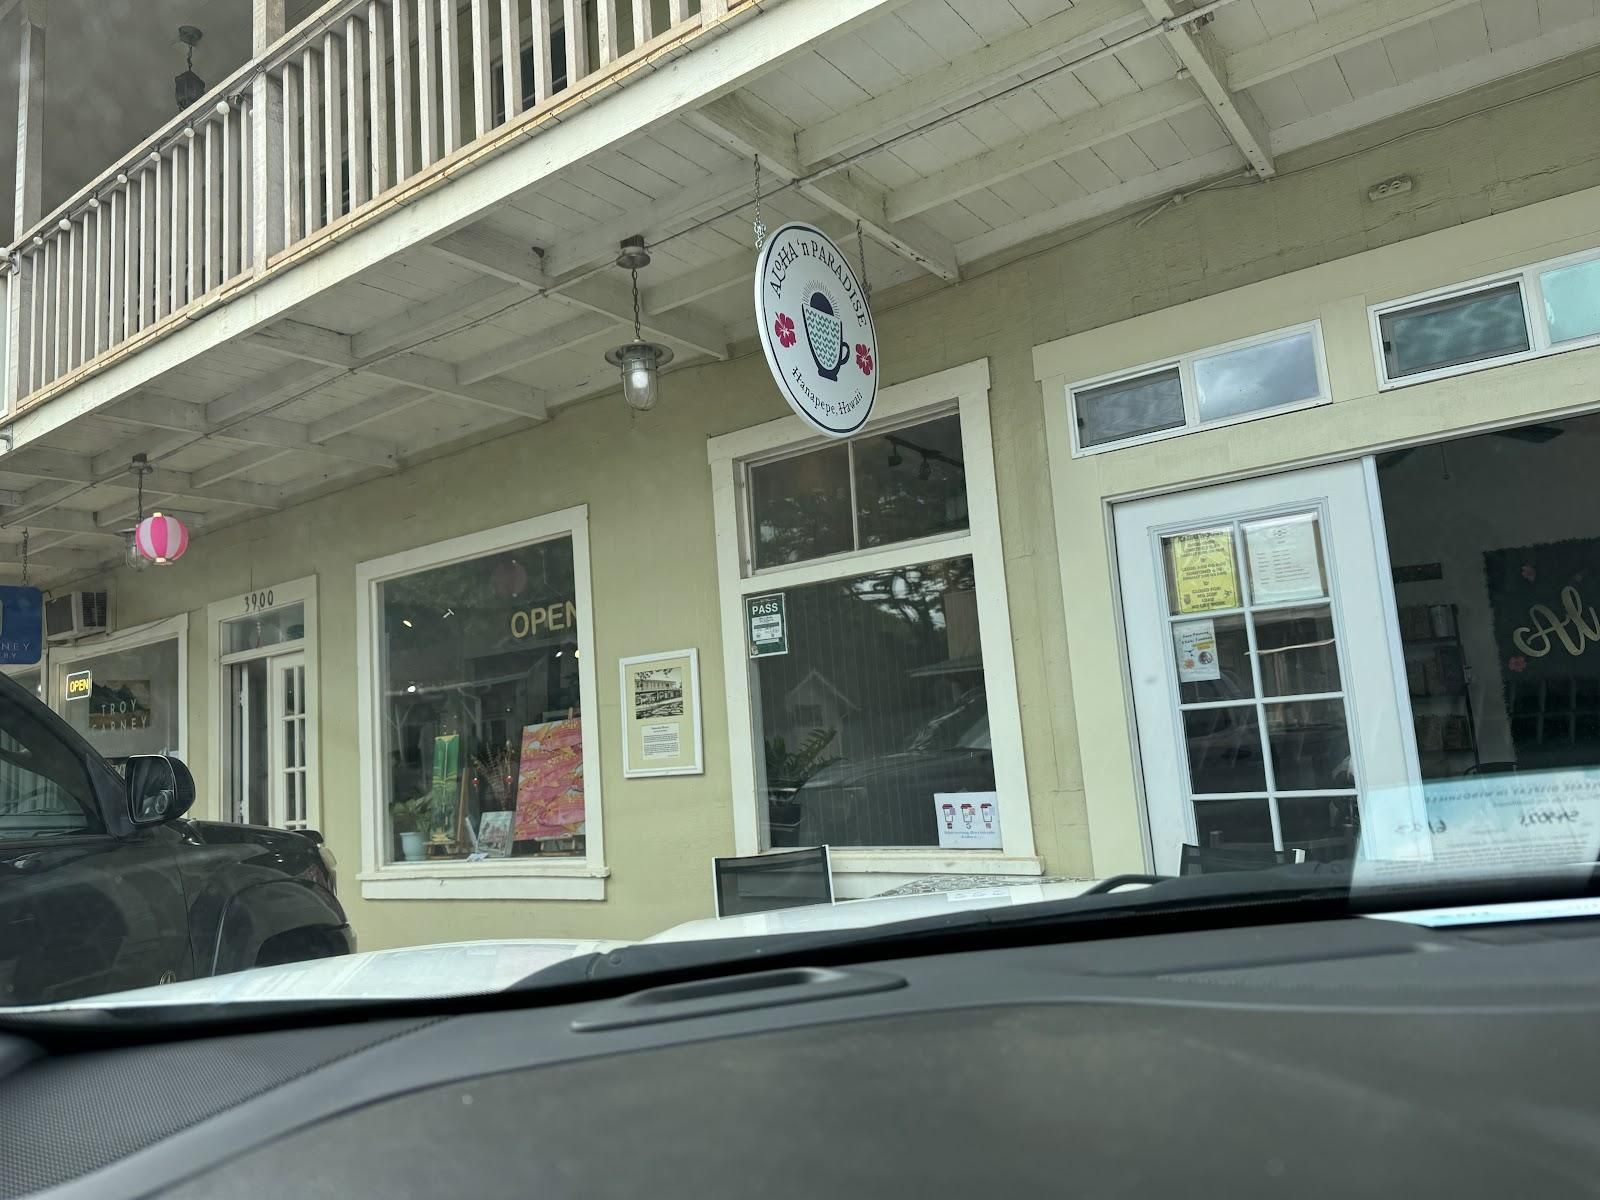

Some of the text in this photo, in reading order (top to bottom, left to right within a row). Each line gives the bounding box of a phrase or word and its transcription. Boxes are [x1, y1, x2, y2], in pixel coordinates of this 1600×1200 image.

[769, 241, 799, 300] ALOHA
[811, 240, 867, 328] PARADISE
[791, 366, 864, 416] Hanapepe, Hawaii
[244, 590, 274, 612] 3900
[752, 602, 779, 616] PASS
[511, 601, 577, 639] OPEN
[70, 678, 89, 693] OPEN
[101, 698, 137, 717] TROY
